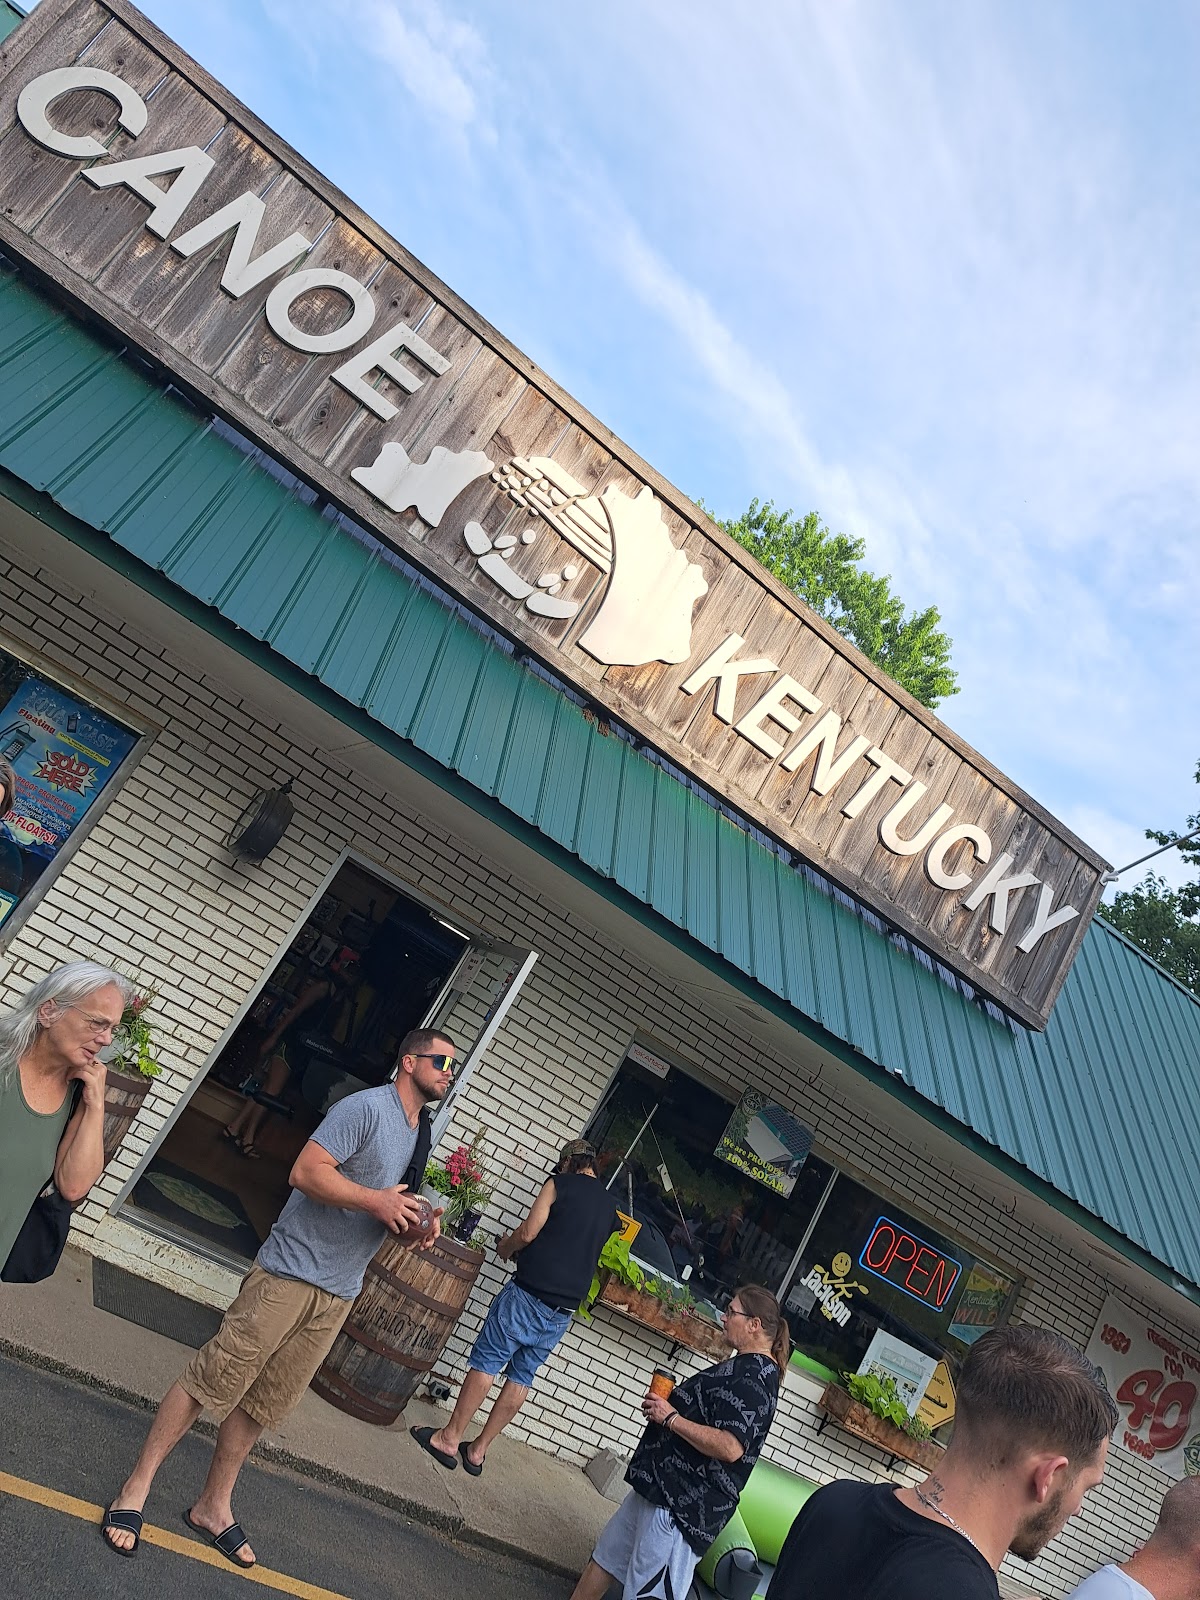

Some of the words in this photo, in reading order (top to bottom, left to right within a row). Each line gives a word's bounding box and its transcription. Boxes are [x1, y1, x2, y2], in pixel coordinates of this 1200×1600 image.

[17, 66, 452, 422] CANOE
[79, 723, 118, 753] CASE
[40, 763, 83, 793] HERE
[48, 751, 90, 777] SOLD
[16, 775, 38, 791] PROOF
[38, 788, 77, 813] PROTECTION
[679, 632, 1079, 954] KENTUCKY
[15, 796, 47, 817] MEMORABLE
[47, 813, 71, 830] MOMENTS
[15, 816, 57, 845] FLOATS!!
[305, 1038, 334, 1055] MotorGuide
[723, 1137, 735, 1149] We
[733, 1145, 746, 1157] are
[725, 1152, 751, 1173] 100%
[866, 1226, 957, 1306] OPEN
[800, 1269, 852, 1327] Jackson
[965, 1290, 997, 1312] Kentucky
[955, 1307, 997, 1327] WILD
[1116, 1369, 1198, 1451] 40
[1123, 1430, 1156, 1461] YEARS
